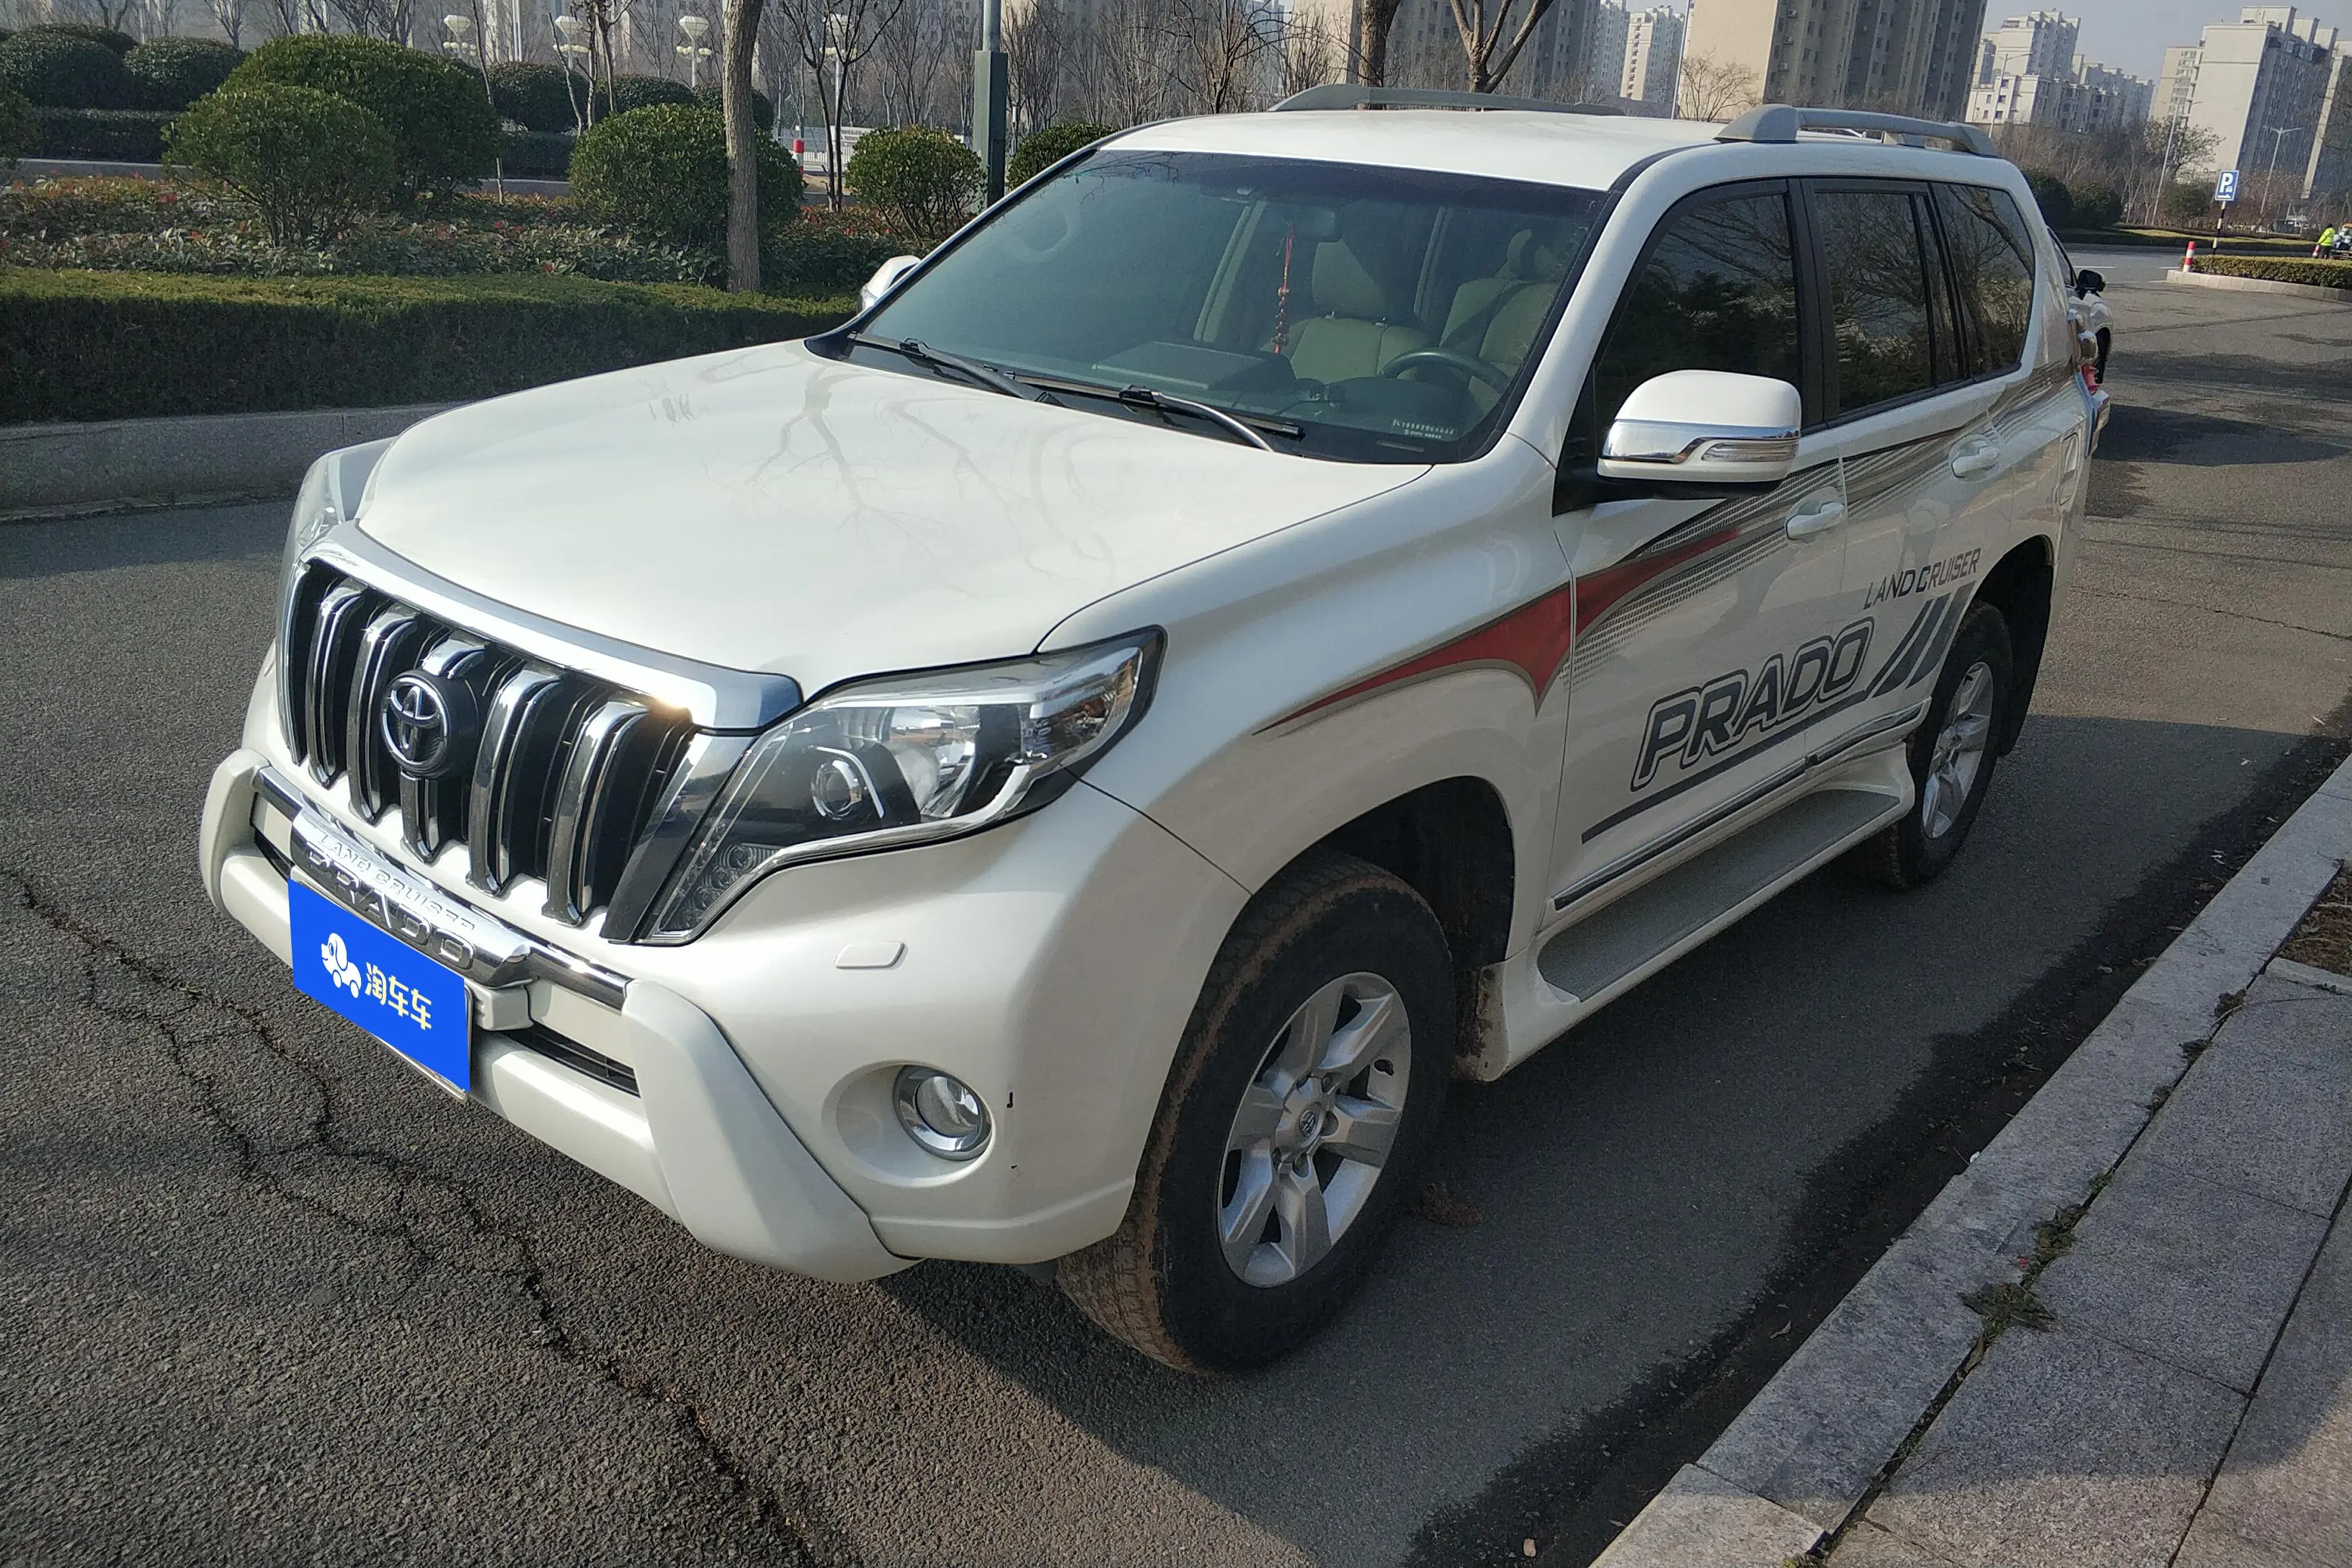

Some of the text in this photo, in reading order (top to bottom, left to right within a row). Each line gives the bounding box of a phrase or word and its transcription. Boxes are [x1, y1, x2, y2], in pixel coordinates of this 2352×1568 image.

[2219, 173, 2233, 192] P
[1863, 548, 1981, 610] LAND CRUISER
[1631, 616, 1874, 792] PRADO
[318, 834, 371, 873] LAND
[306, 841, 476, 970] PRADO
